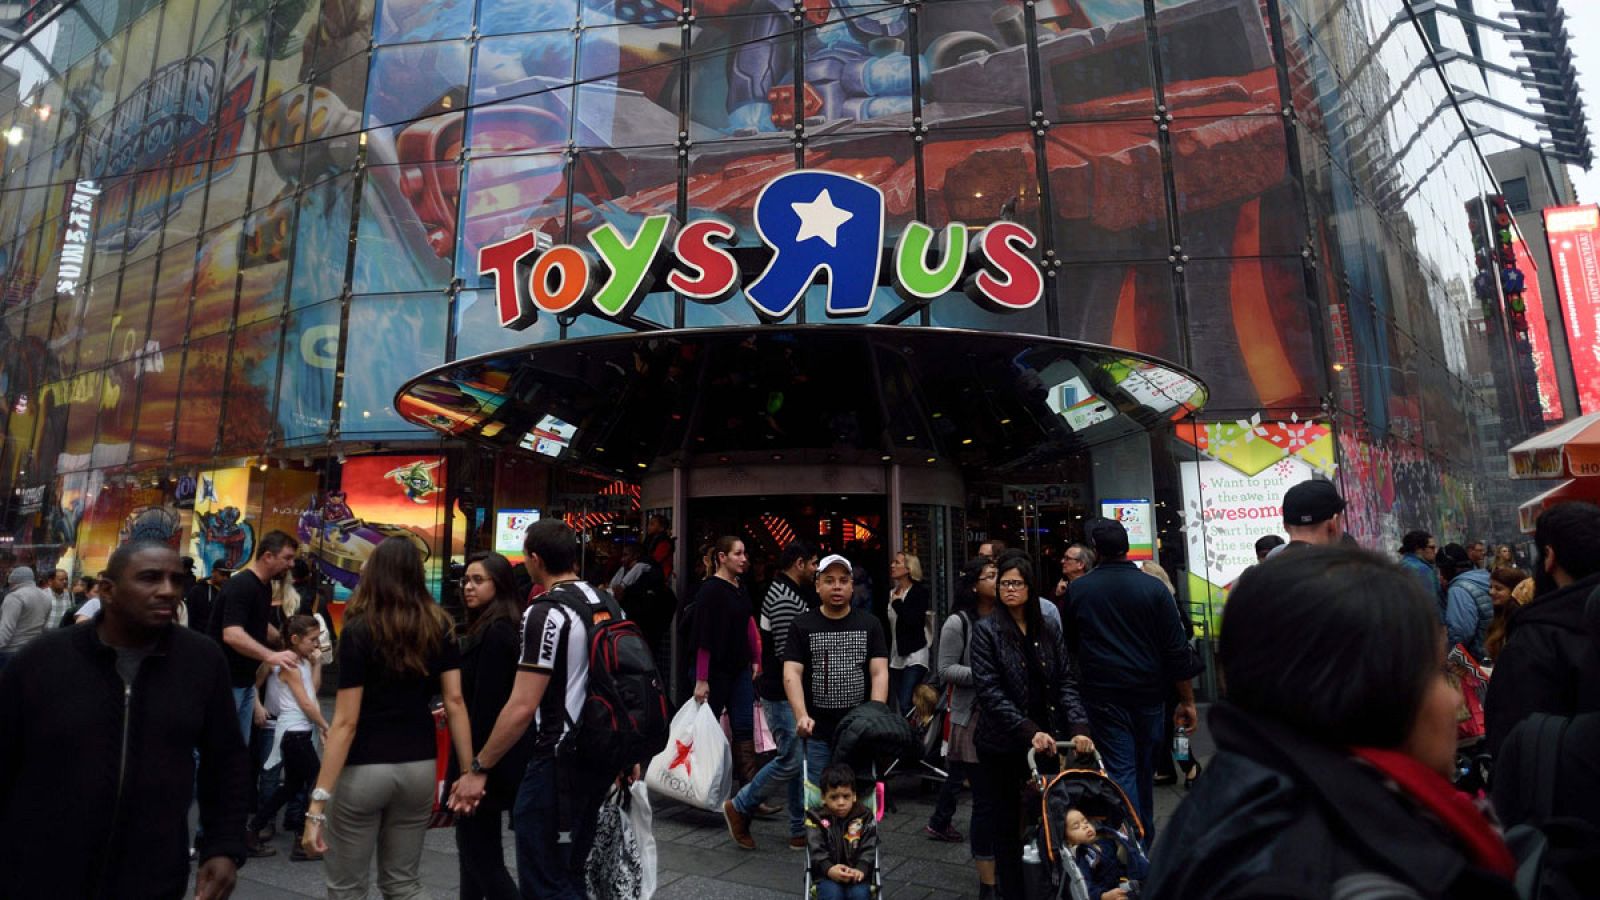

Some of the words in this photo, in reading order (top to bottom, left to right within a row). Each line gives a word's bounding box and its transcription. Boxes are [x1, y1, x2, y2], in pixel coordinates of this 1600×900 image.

[478, 214, 739, 328] TOYS
[896, 220, 1044, 309] US
[1210, 477, 1244, 488] Want
[1247, 478, 1260, 487] to
[1264, 477, 1284, 489] put
[1218, 491, 1238, 502] the
[1240, 492, 1264, 501] awe
[1267, 490, 1280, 500] in
[1211, 525, 1242, 536] Sart
[1245, 525, 1272, 535] here
[1216, 539, 1236, 550] the
[541, 619, 557, 660] MRV
